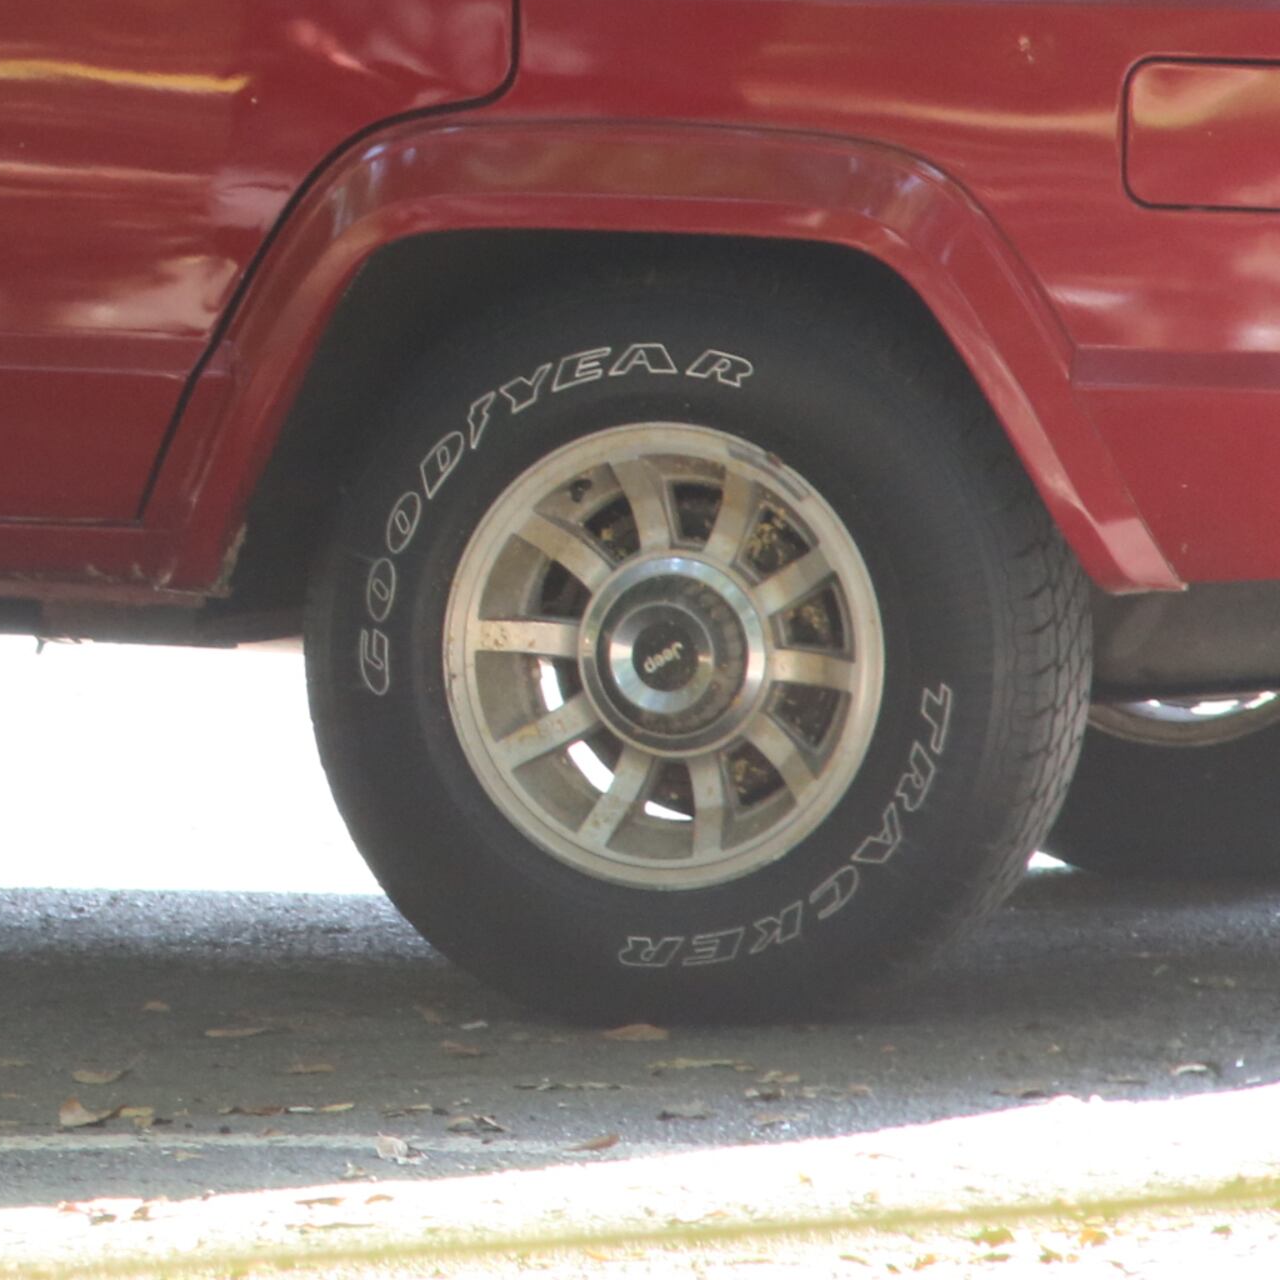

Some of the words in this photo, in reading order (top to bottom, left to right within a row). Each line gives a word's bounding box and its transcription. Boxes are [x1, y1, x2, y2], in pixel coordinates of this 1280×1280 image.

[359, 343, 754, 696] GOODYEAR
[643, 641, 684, 673] Jeep
[617, 683, 953, 967] TRACKER
